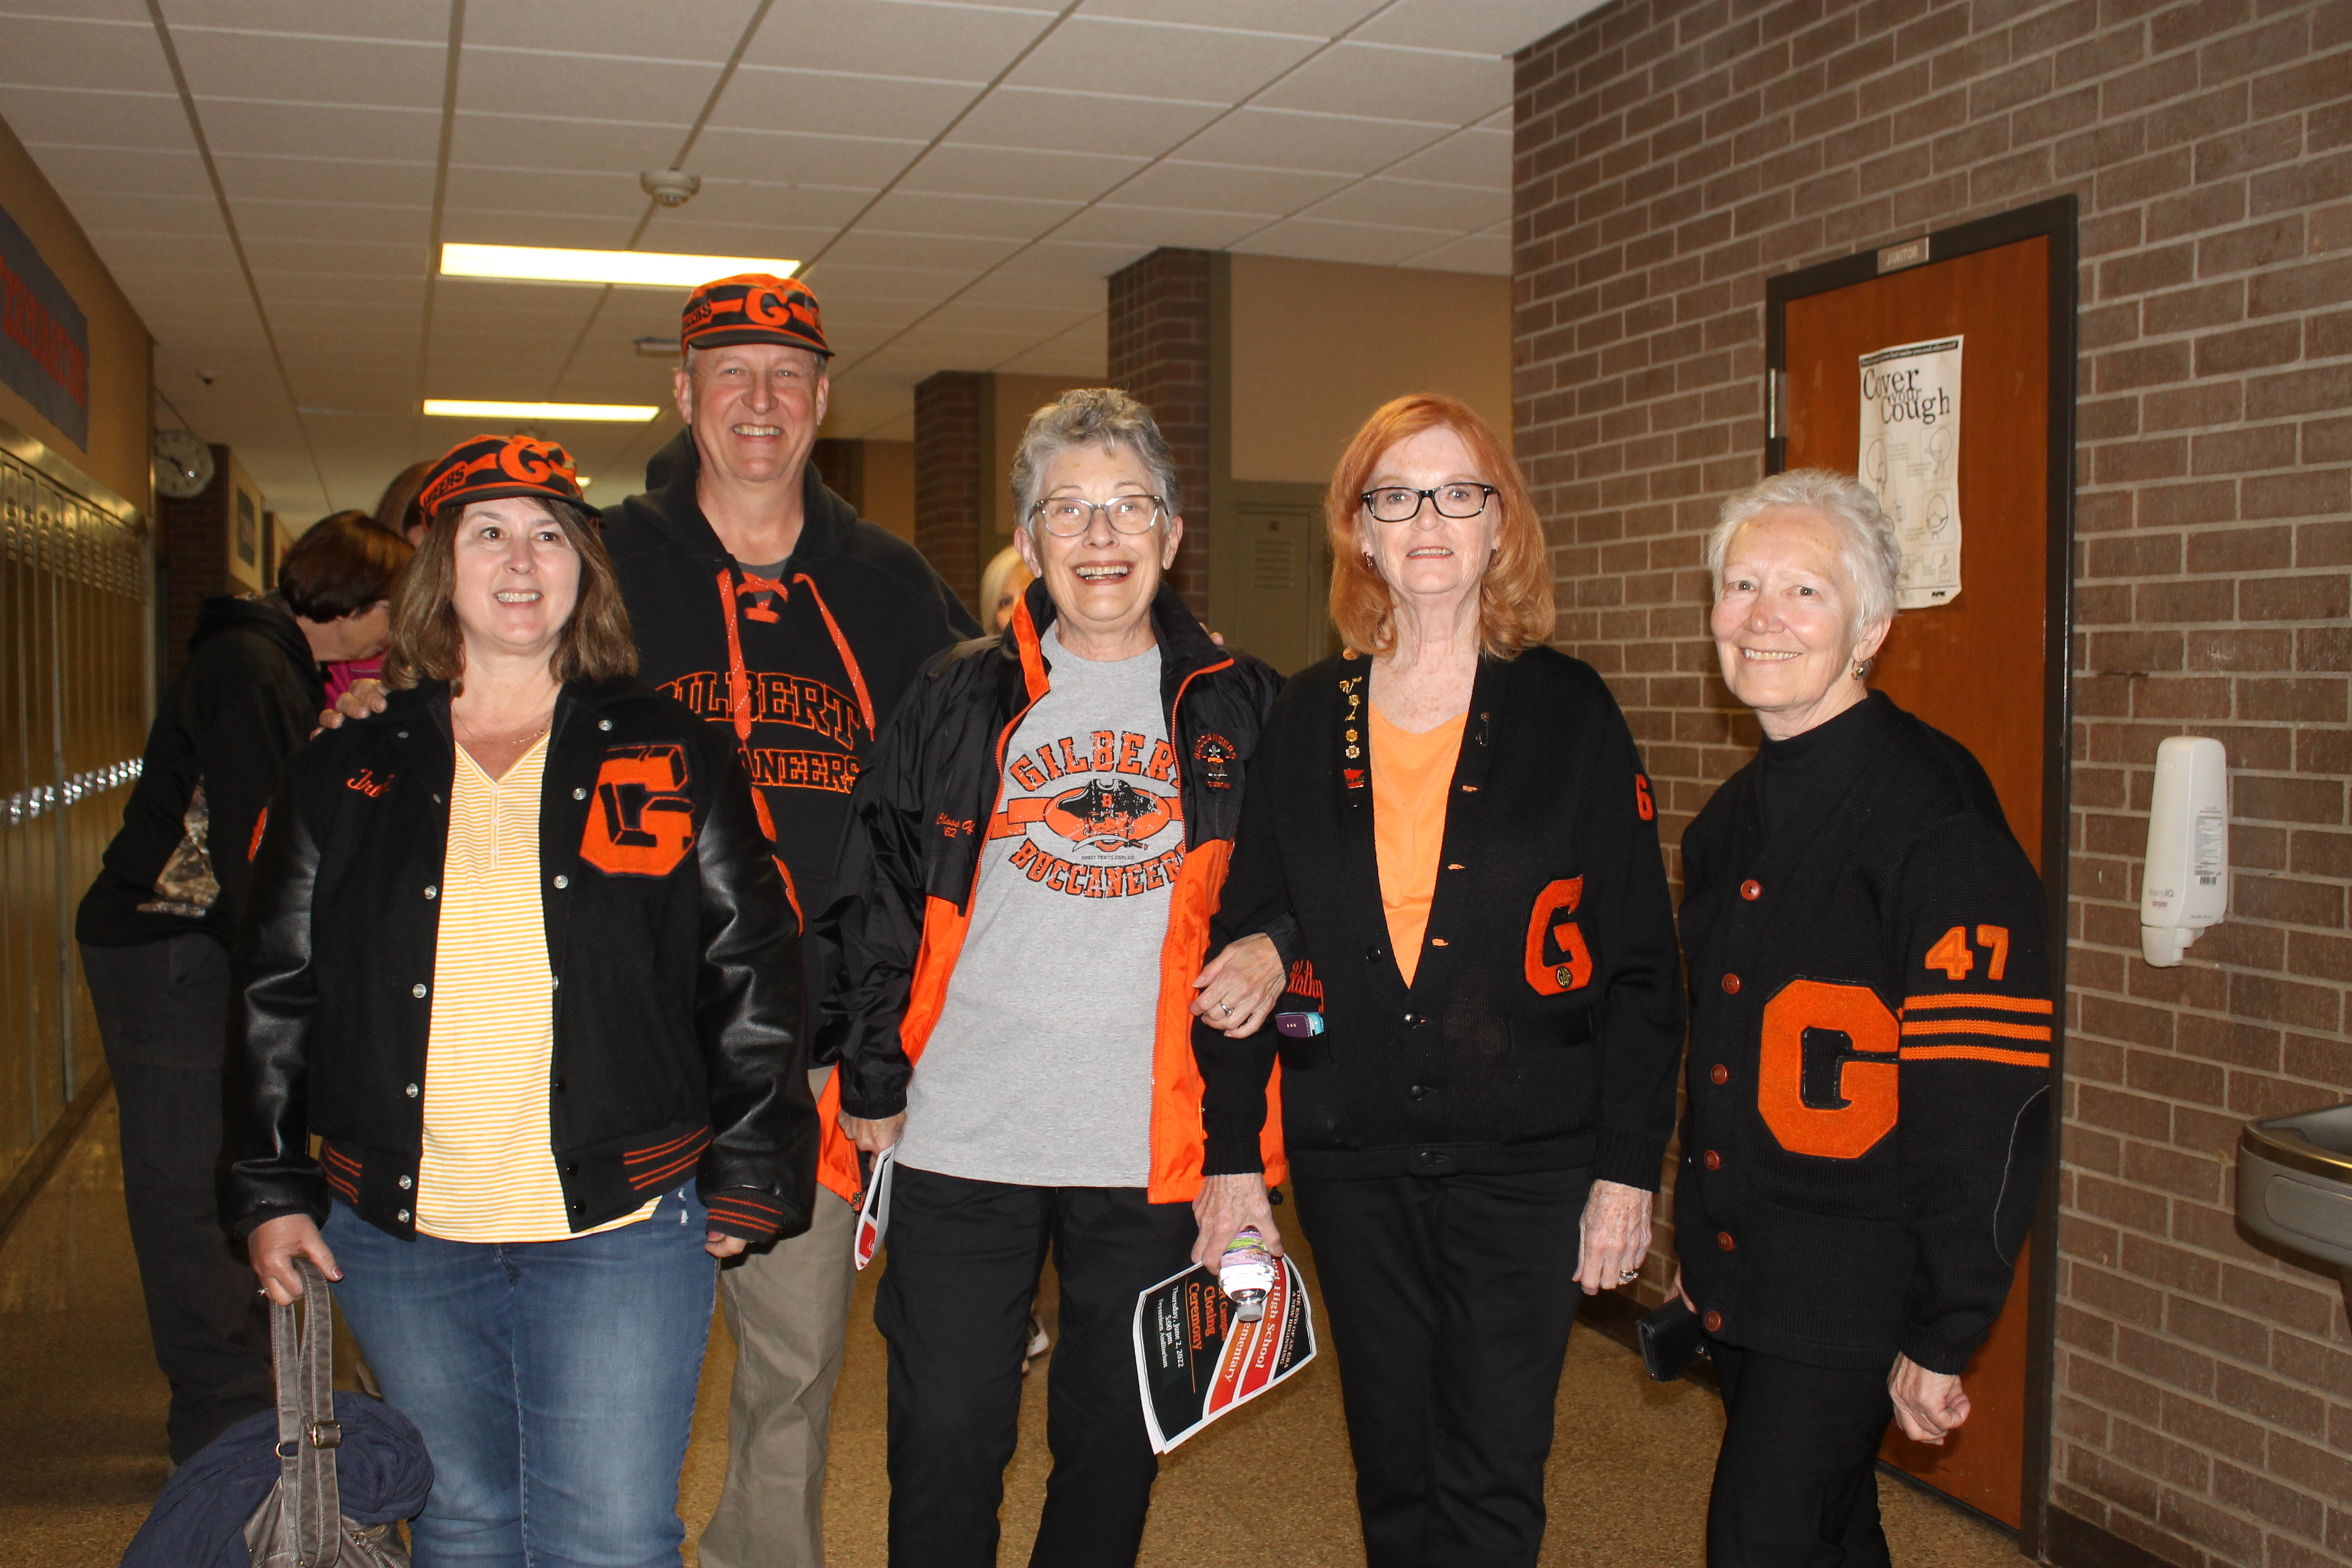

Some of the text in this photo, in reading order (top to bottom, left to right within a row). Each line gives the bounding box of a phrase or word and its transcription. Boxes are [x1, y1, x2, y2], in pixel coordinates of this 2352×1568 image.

[1864, 368, 1921, 400] Cover
[1881, 387, 1950, 424] Cough
[1890, 389, 1921, 406] your
[1009, 729, 1178, 792] GILBER
[1194, 733, 1238, 760] BUCCANEERS
[579, 743, 696, 876] G
[1525, 874, 1593, 996] G
[1925, 924, 2009, 981] 47
[1758, 978, 1899, 1159] G
[1166, 1331, 1173, 1345] pm
[1189, 1282, 1202, 1349] Ceremony
[1204, 1286, 1217, 1337] Closing
[1255, 1259, 1281, 1369] ert High School
[1159, 1332, 1168, 1368] Auditorium
[1175, 1341, 1182, 1349] 2,
[1224, 1322, 1251, 1382] ementary
